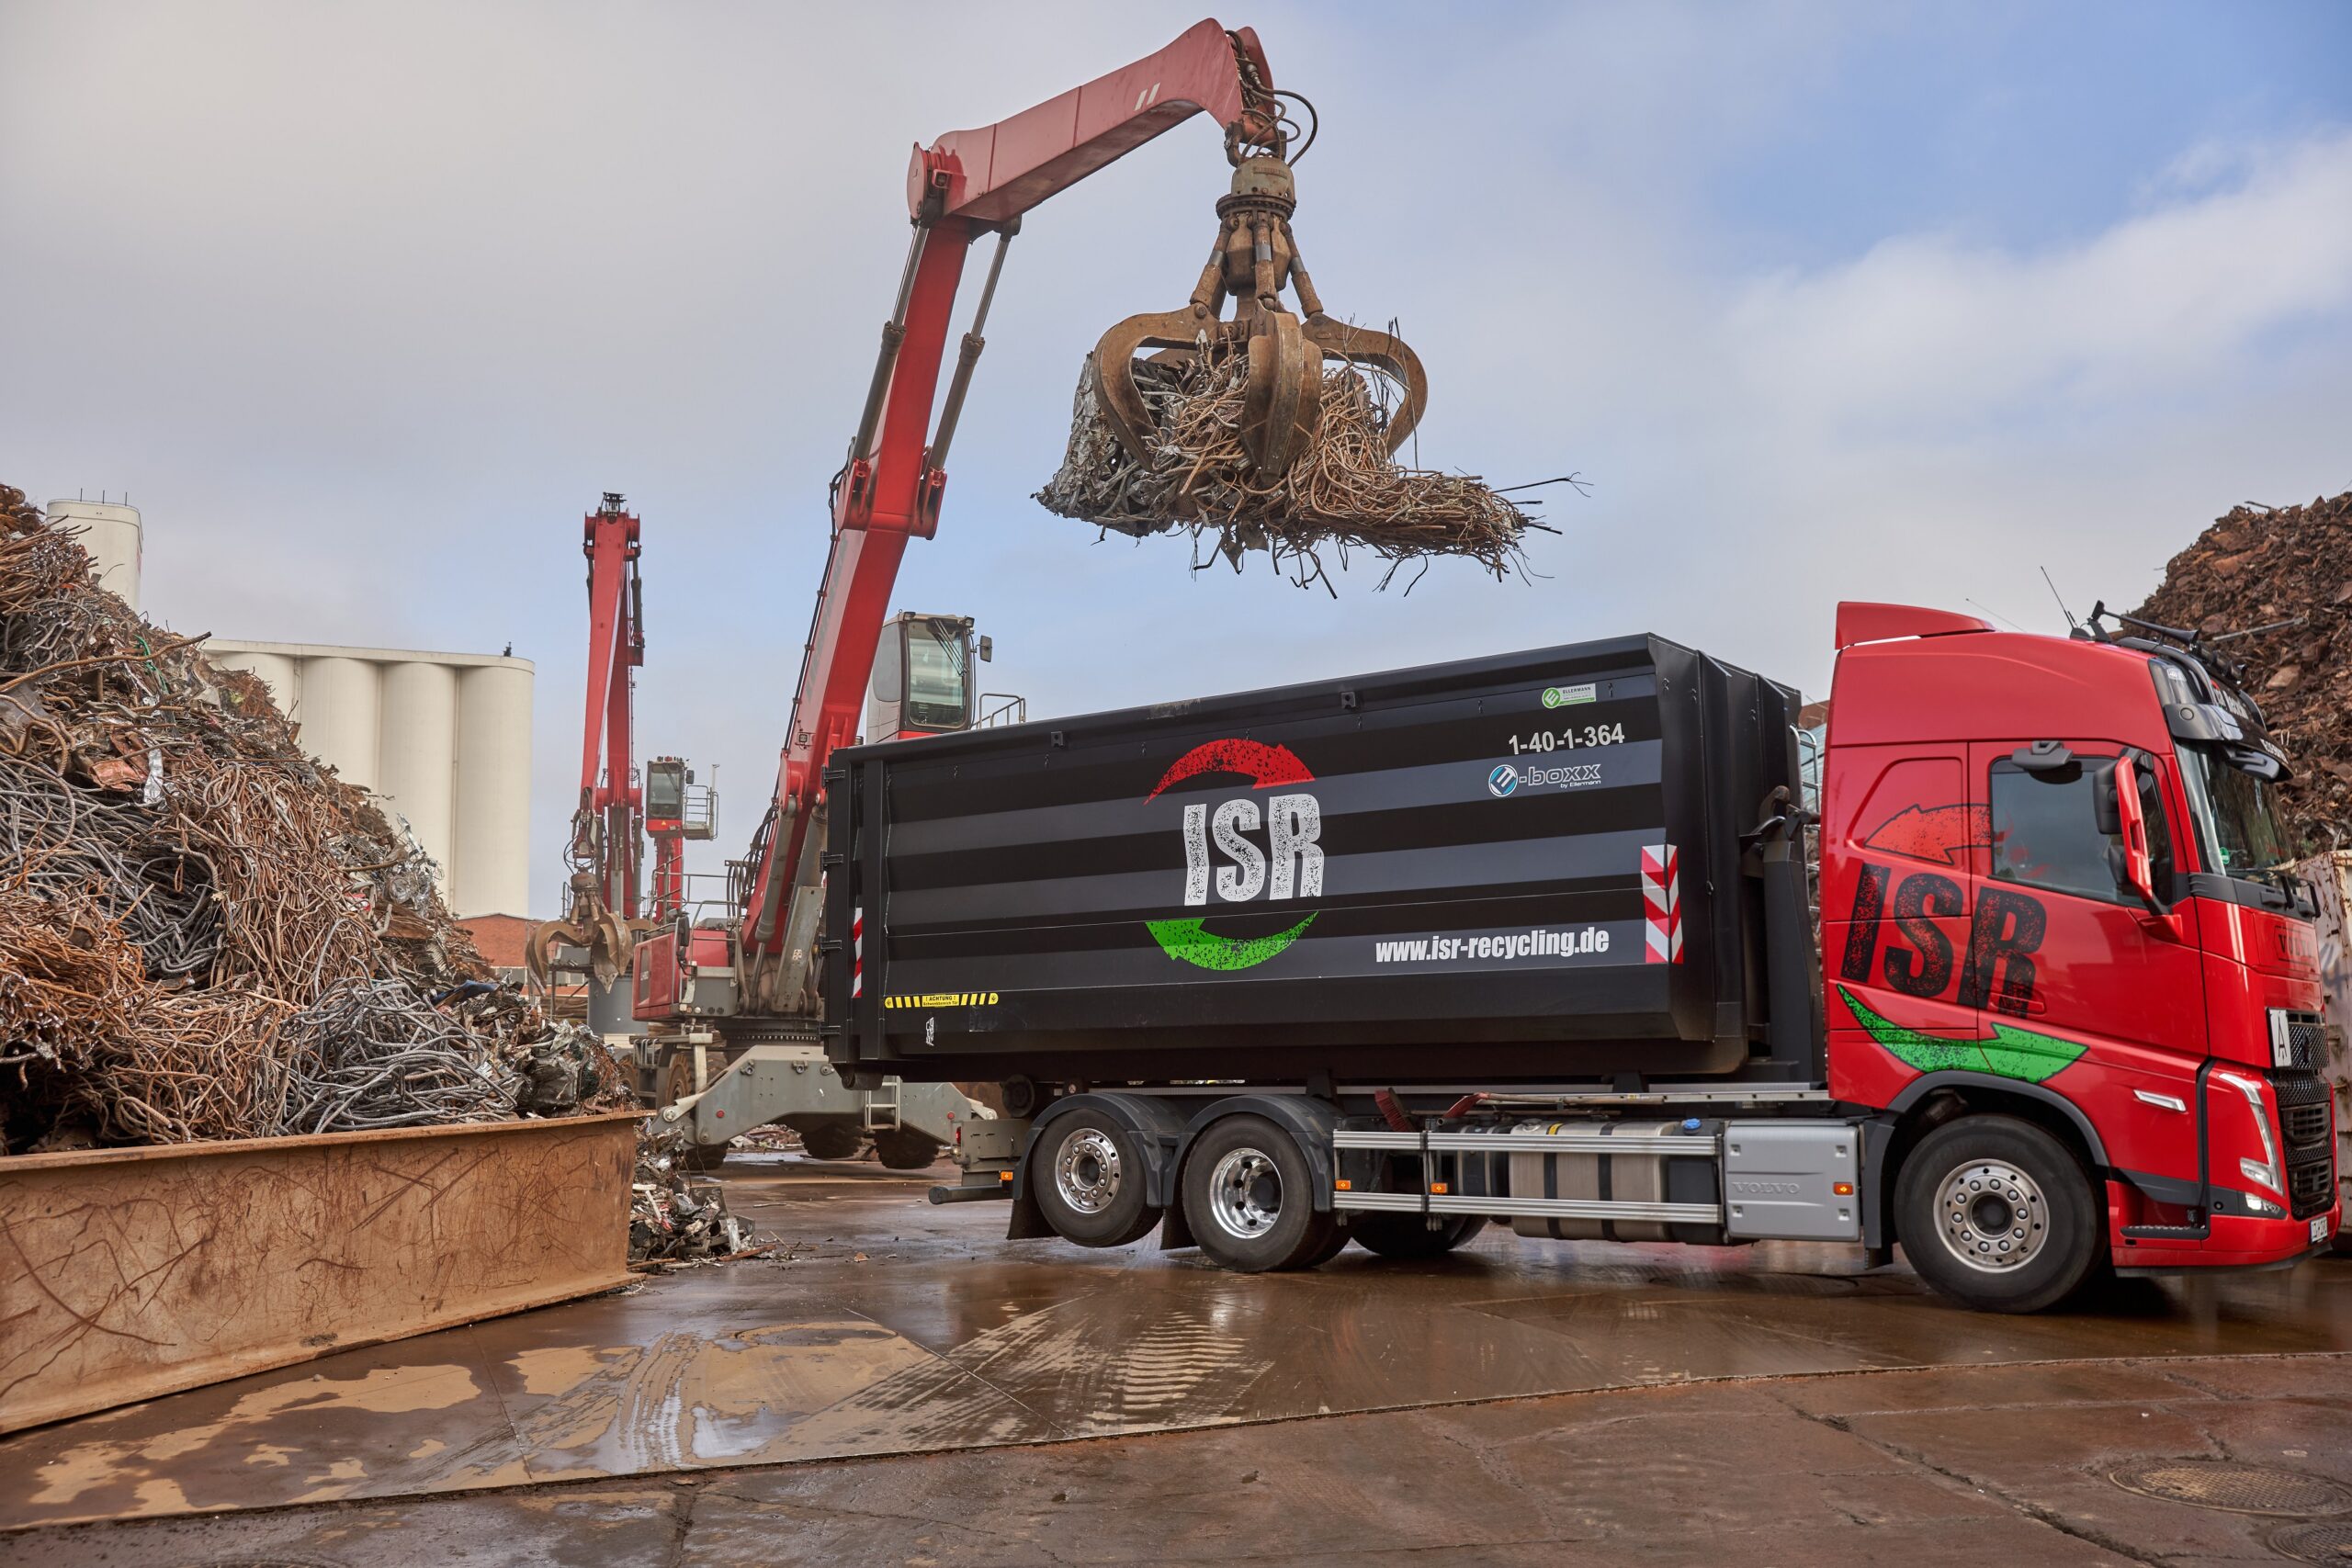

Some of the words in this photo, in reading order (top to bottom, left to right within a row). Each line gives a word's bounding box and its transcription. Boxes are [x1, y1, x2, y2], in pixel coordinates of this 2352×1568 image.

[1509, 723, 1624, 755] 1-40-1-364
[1183, 794, 1325, 907] ISR
[1375, 927, 1610, 963] www.isr-recycling.de
[1840, 862, 2047, 1020] ISR
[1732, 1181, 1800, 1194] VOLVO
